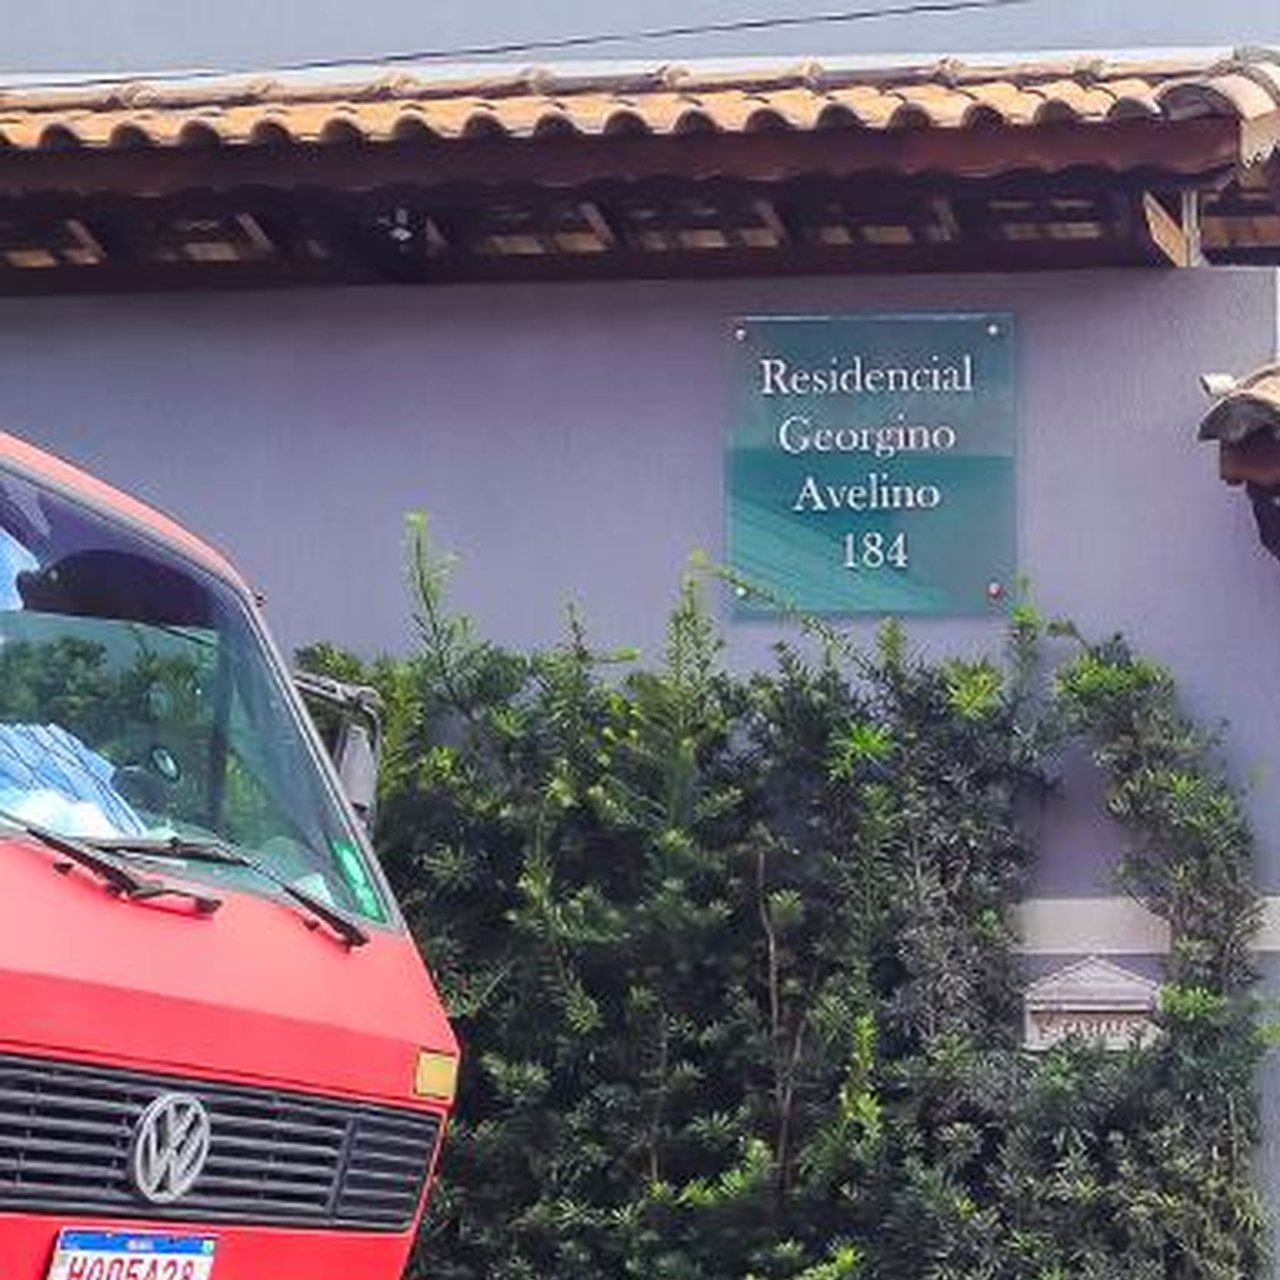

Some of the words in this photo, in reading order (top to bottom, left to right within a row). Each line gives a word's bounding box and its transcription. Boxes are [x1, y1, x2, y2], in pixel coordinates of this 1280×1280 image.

[760, 355, 974, 395] Residencial
[778, 414, 956, 457] Georgino
[793, 473, 941, 512] Avelino
[843, 532, 909, 569] 184
